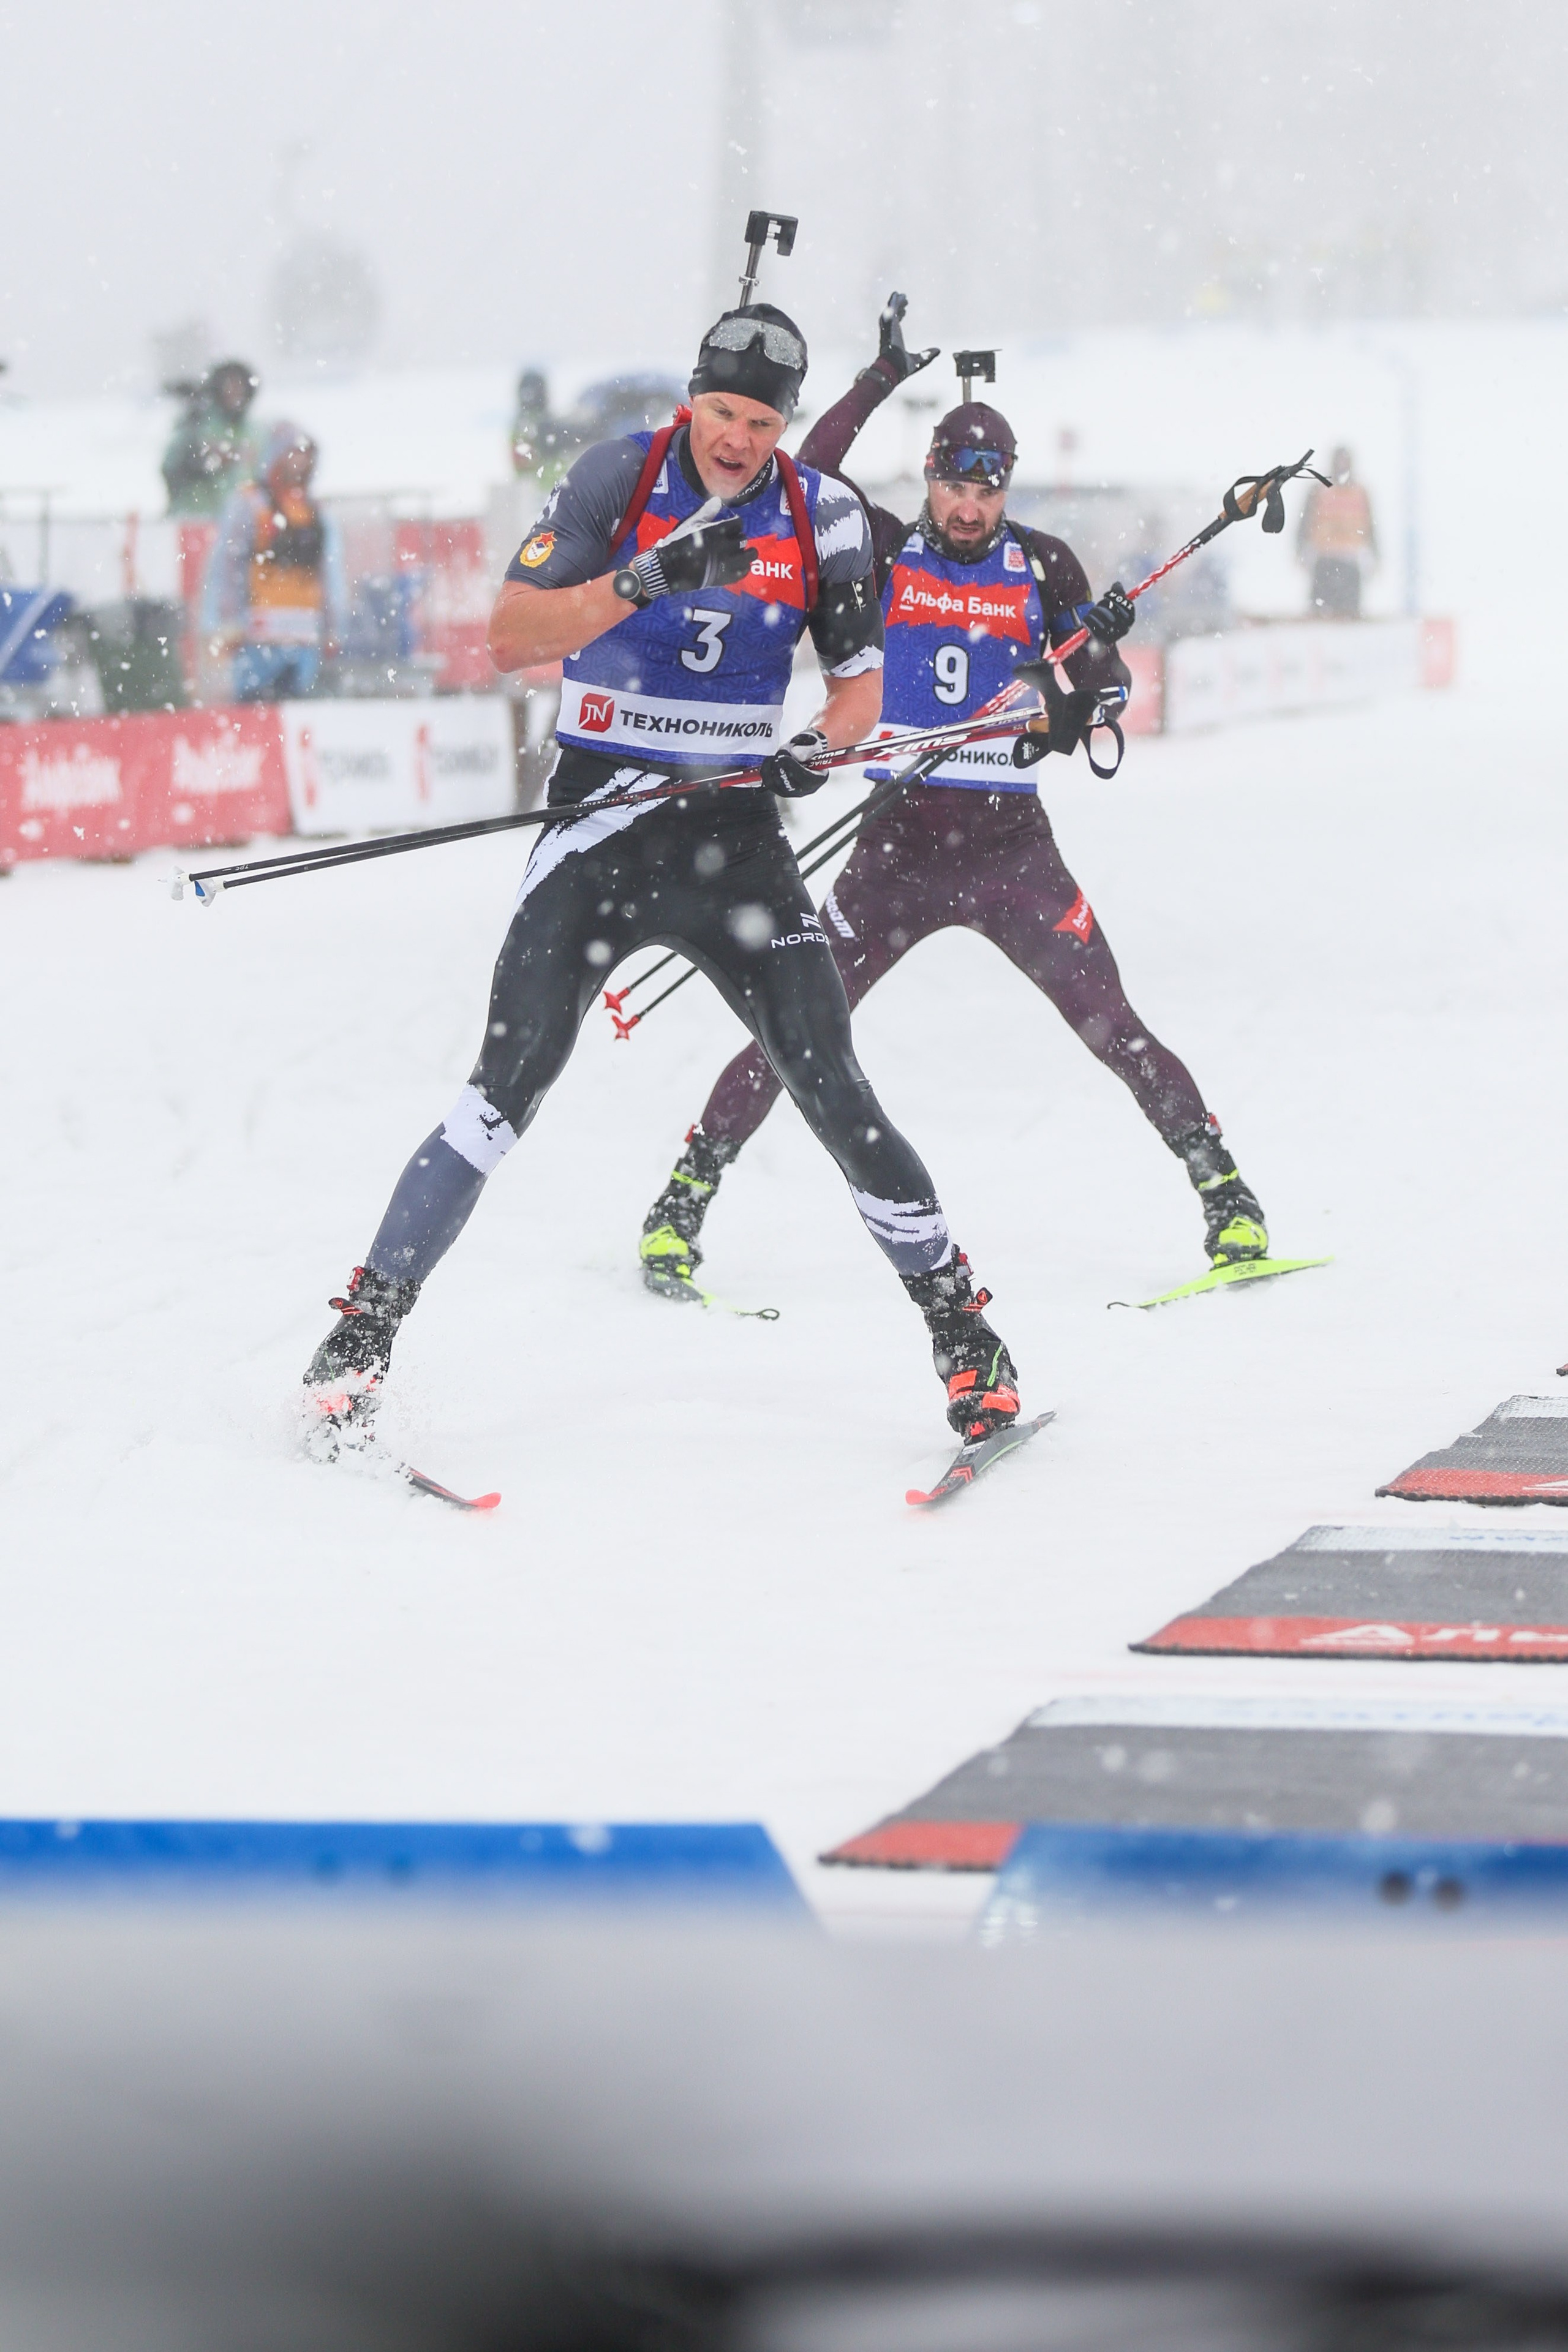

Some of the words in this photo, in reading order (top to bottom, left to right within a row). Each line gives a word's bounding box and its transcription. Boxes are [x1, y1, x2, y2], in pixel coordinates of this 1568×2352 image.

[750, 559, 793, 580] анк
[899, 584, 964, 614] Альфа
[968, 596, 1017, 619] Банк
[680, 608, 732, 673] 3
[934, 644, 969, 705] 9
[620, 709, 773, 738] ТЕХНОНИКОЛЬ
